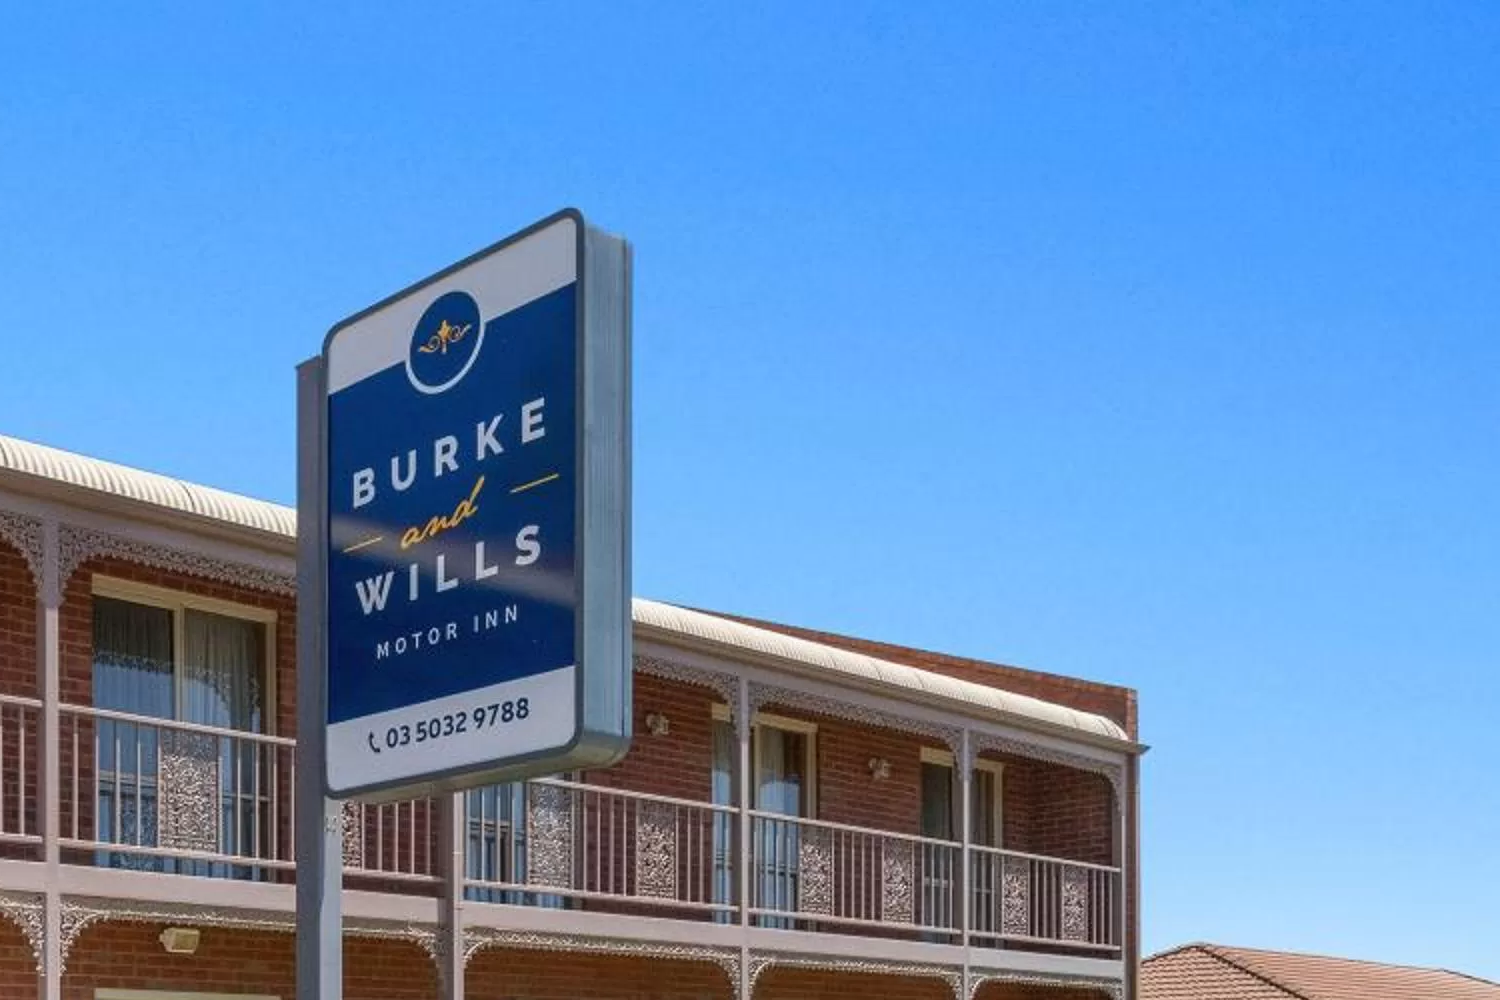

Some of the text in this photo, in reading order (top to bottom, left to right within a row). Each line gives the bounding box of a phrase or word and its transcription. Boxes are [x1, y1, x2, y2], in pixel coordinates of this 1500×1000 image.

[353, 397, 546, 509] BURKE
[401, 475, 485, 549] and
[355, 524, 541, 615] WILLS
[376, 603, 518, 660] MOTOR INN
[386, 697, 529, 748] 03 5032 9788
